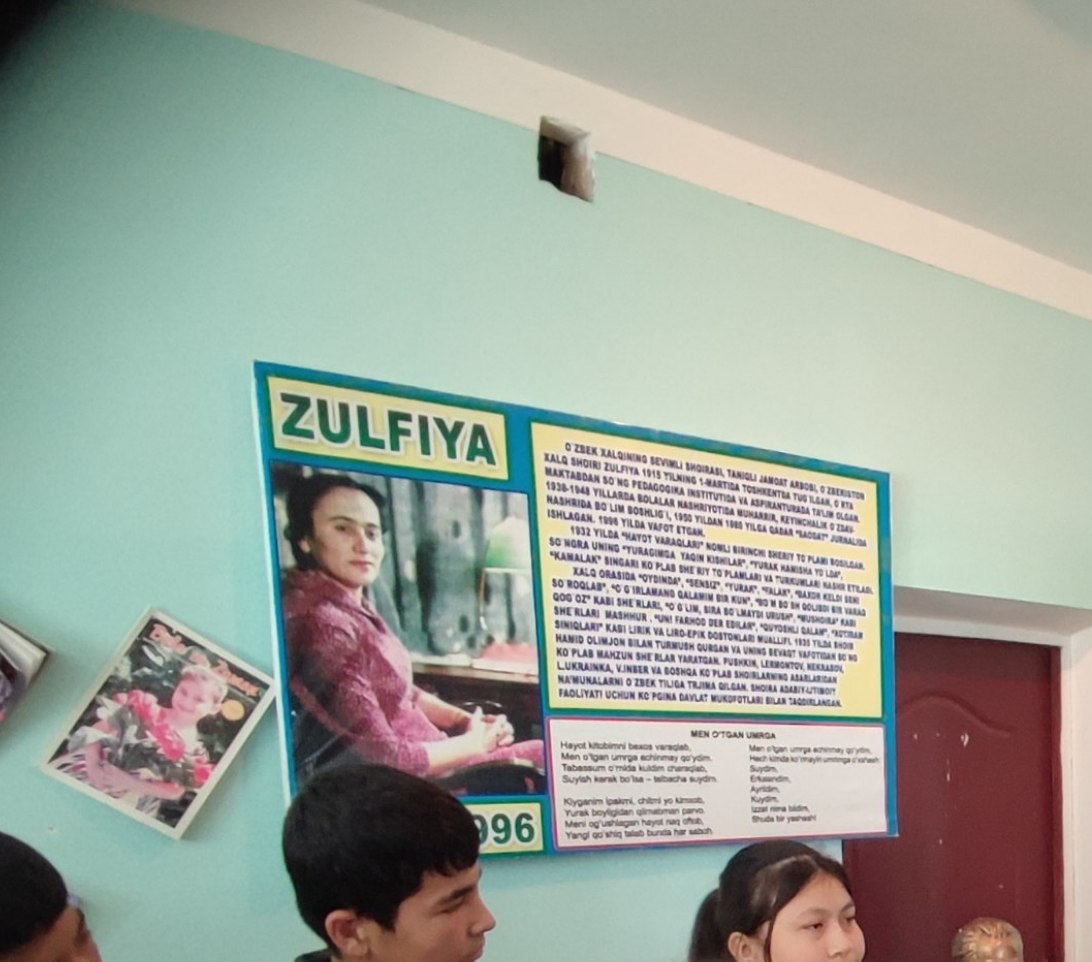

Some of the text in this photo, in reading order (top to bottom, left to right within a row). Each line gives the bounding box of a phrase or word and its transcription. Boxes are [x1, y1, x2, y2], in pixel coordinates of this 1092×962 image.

[280, 392, 496, 466] ZULFIYA
[600, 447, 648, 465] XALQINING
[649, 455, 683, 470] SEVIMLI
[543, 451, 568, 466] XALQ
[570, 455, 602, 471] SHOIRI
[603, 461, 639, 477] ZULFIYA
[663, 470, 697, 485] YILNING
[698, 476, 740, 492] 1-MARTIDA
[544, 465, 600, 484] MAKTABDAN
[592, 486, 635, 502] YILLARDA
[636, 492, 675, 508] BOLALAR
[545, 493, 592, 510] NASHRIDA
[694, 514, 723, 527] YILDAN
[620, 516, 645, 530] YILDA
[647, 520, 674, 534] VAFOT
[593, 527, 619, 540] YILDA
[705, 541, 731, 553] NOMLI
[591, 540, 620, 553] UNING
[680, 551, 705, 563] YAQIN
[603, 555, 639, 569] SINGARI
[572, 565, 597, 578] XALQ
[598, 568, 636, 582] ORASIDA
[592, 594, 614, 606] KABI
[703, 604, 721, 615] SIRA
[676, 589, 714, 602] QALAMIM
[715, 592, 729, 603] BIR
[604, 609, 647, 622] MASHHUR
[674, 614, 706, 627] FARHOD
[707, 617, 724, 628] DER
[604, 622, 626, 634] KABI
[627, 624, 651, 636] LIRIK
[652, 626, 664, 636] VA
[665, 627, 706, 639] LIRO-EPIK
[554, 632, 584, 644] HAMID
[586, 634, 626, 647] OLIMJON
[627, 637, 653, 649] BILAN
[654, 639, 695, 651] TURMUSH
[696, 642, 729, 654] QURGAN
[730, 644, 741, 654] VA
[595, 649, 633, 661] MAHZUN
[615, 663, 649, 675] V.INBER
[650, 665, 662, 675] VA
[663, 666, 697, 677] BOSHQA
[658, 678, 685, 689] TILIGA
[557, 687, 603, 699] FAOLIYATI
[604, 689, 636, 700] UCHUN
[678, 692, 708, 702] DAVLAT
[564, 808, 589, 817] Yurak
